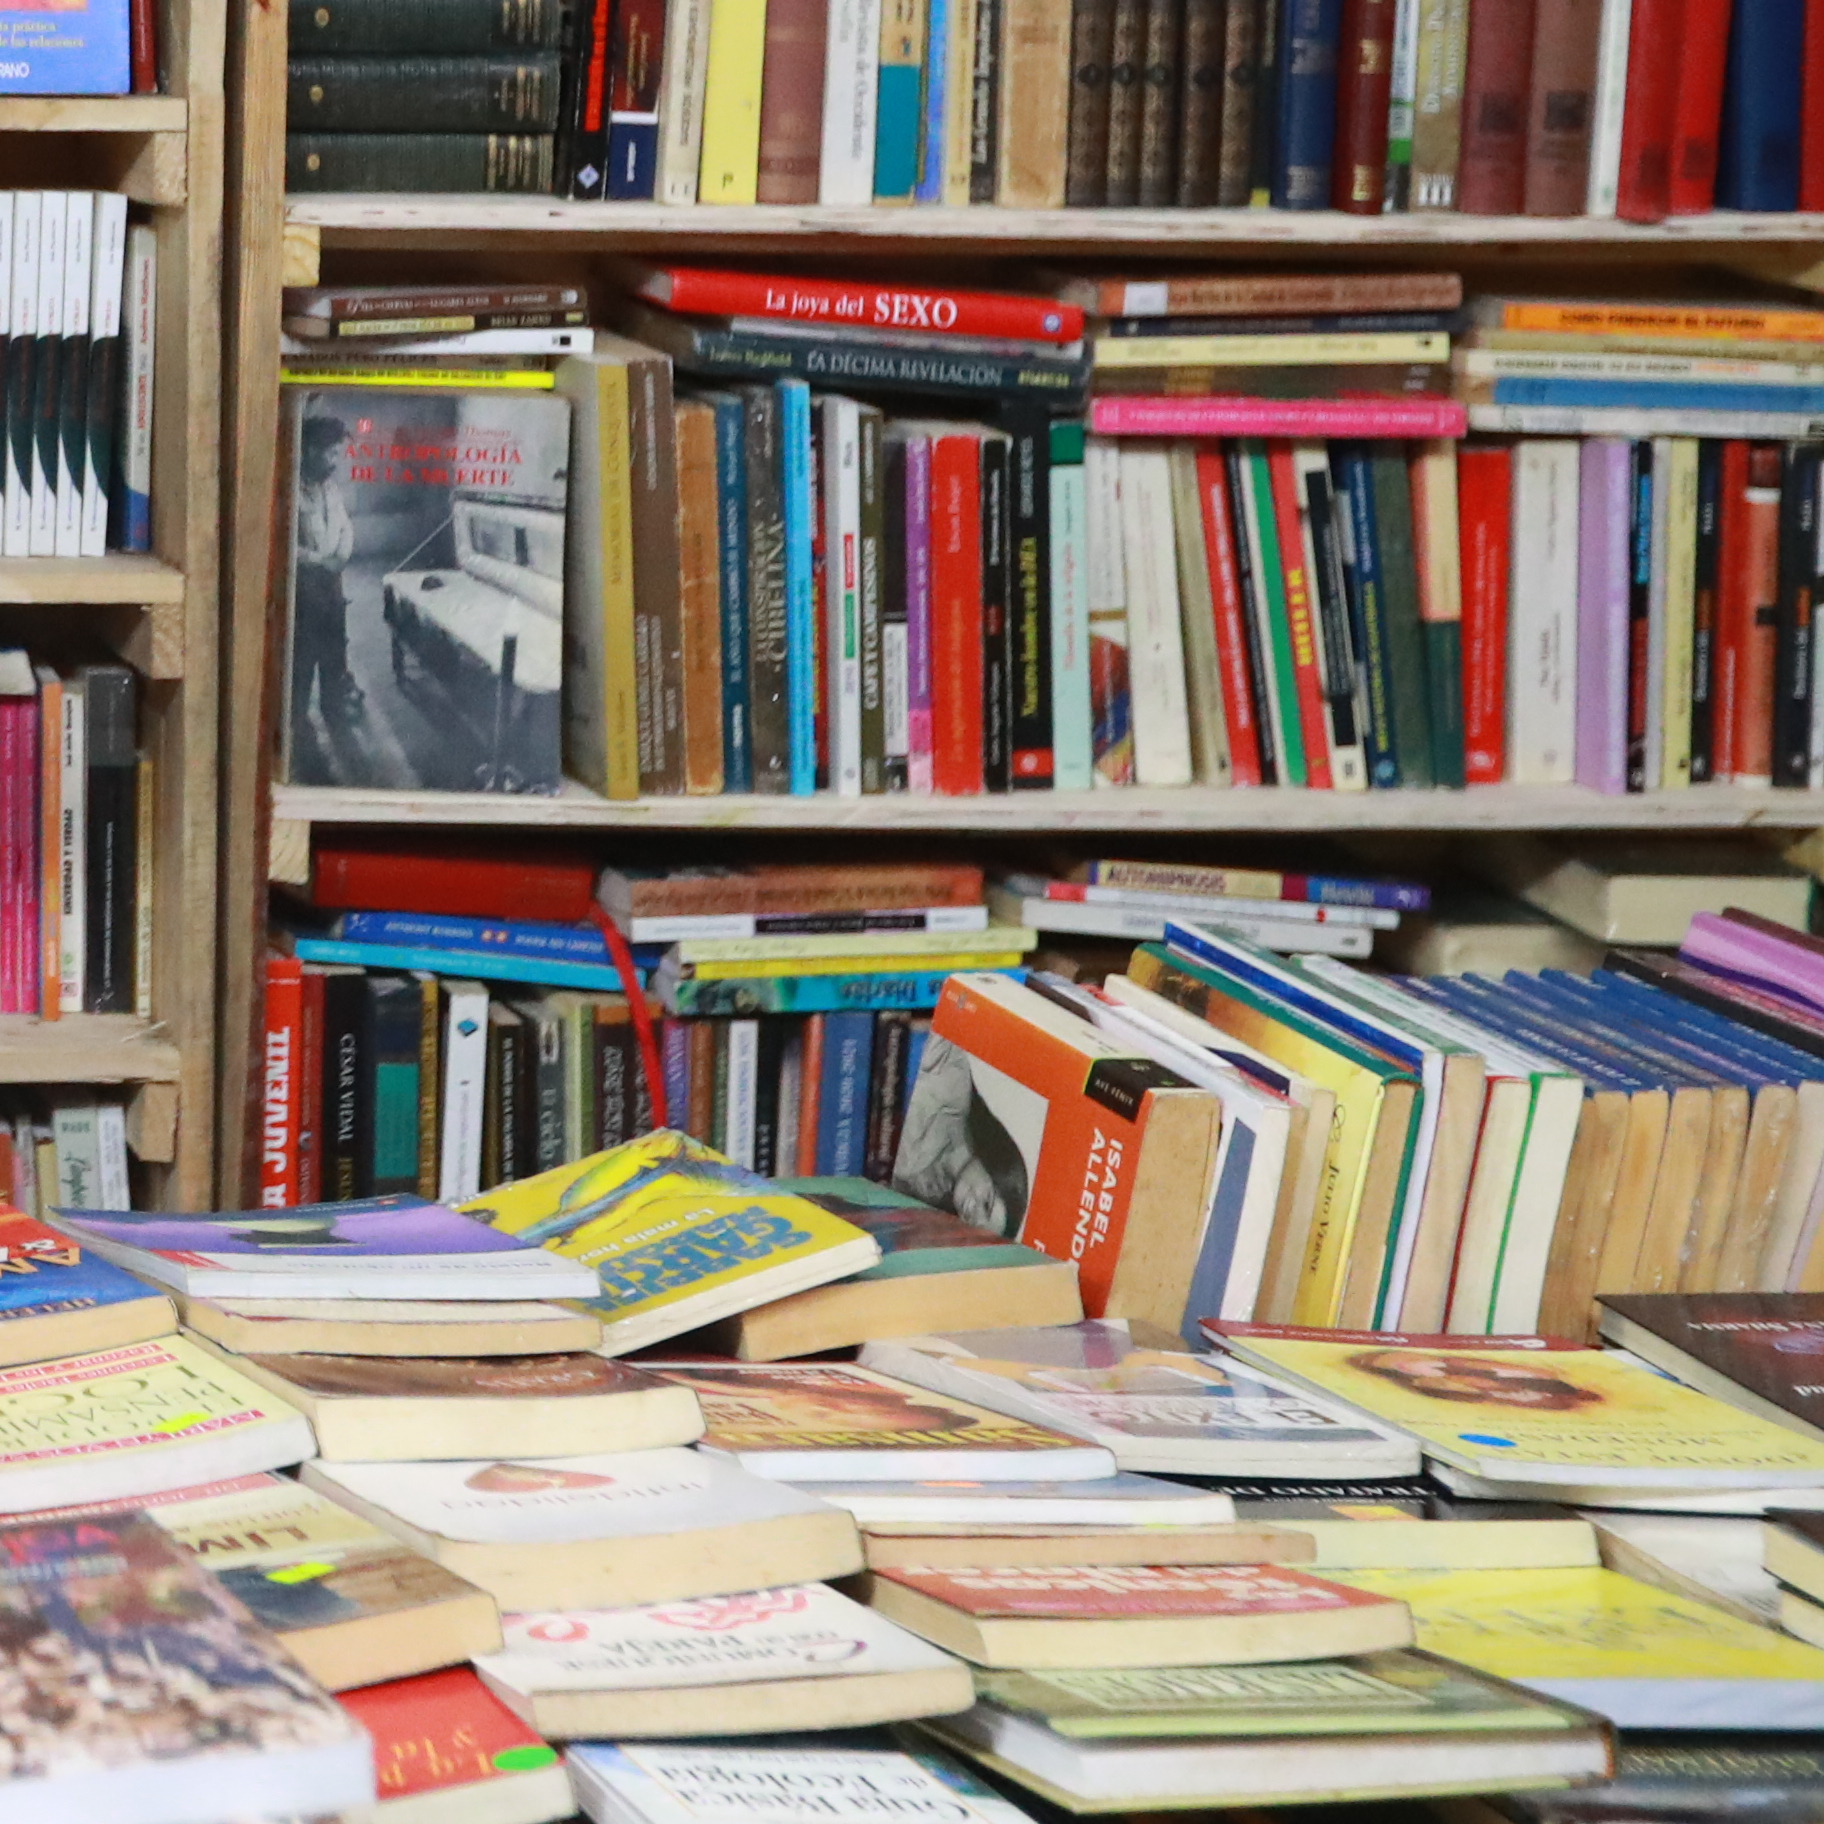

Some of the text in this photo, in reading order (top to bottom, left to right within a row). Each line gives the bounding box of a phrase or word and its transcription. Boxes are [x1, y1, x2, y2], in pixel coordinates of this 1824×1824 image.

[765, 289, 958, 329] La joya del SEXO
[265, 1026, 291, 1173] JUVENIL
[1088, 1139, 1124, 1247] ISABEL
